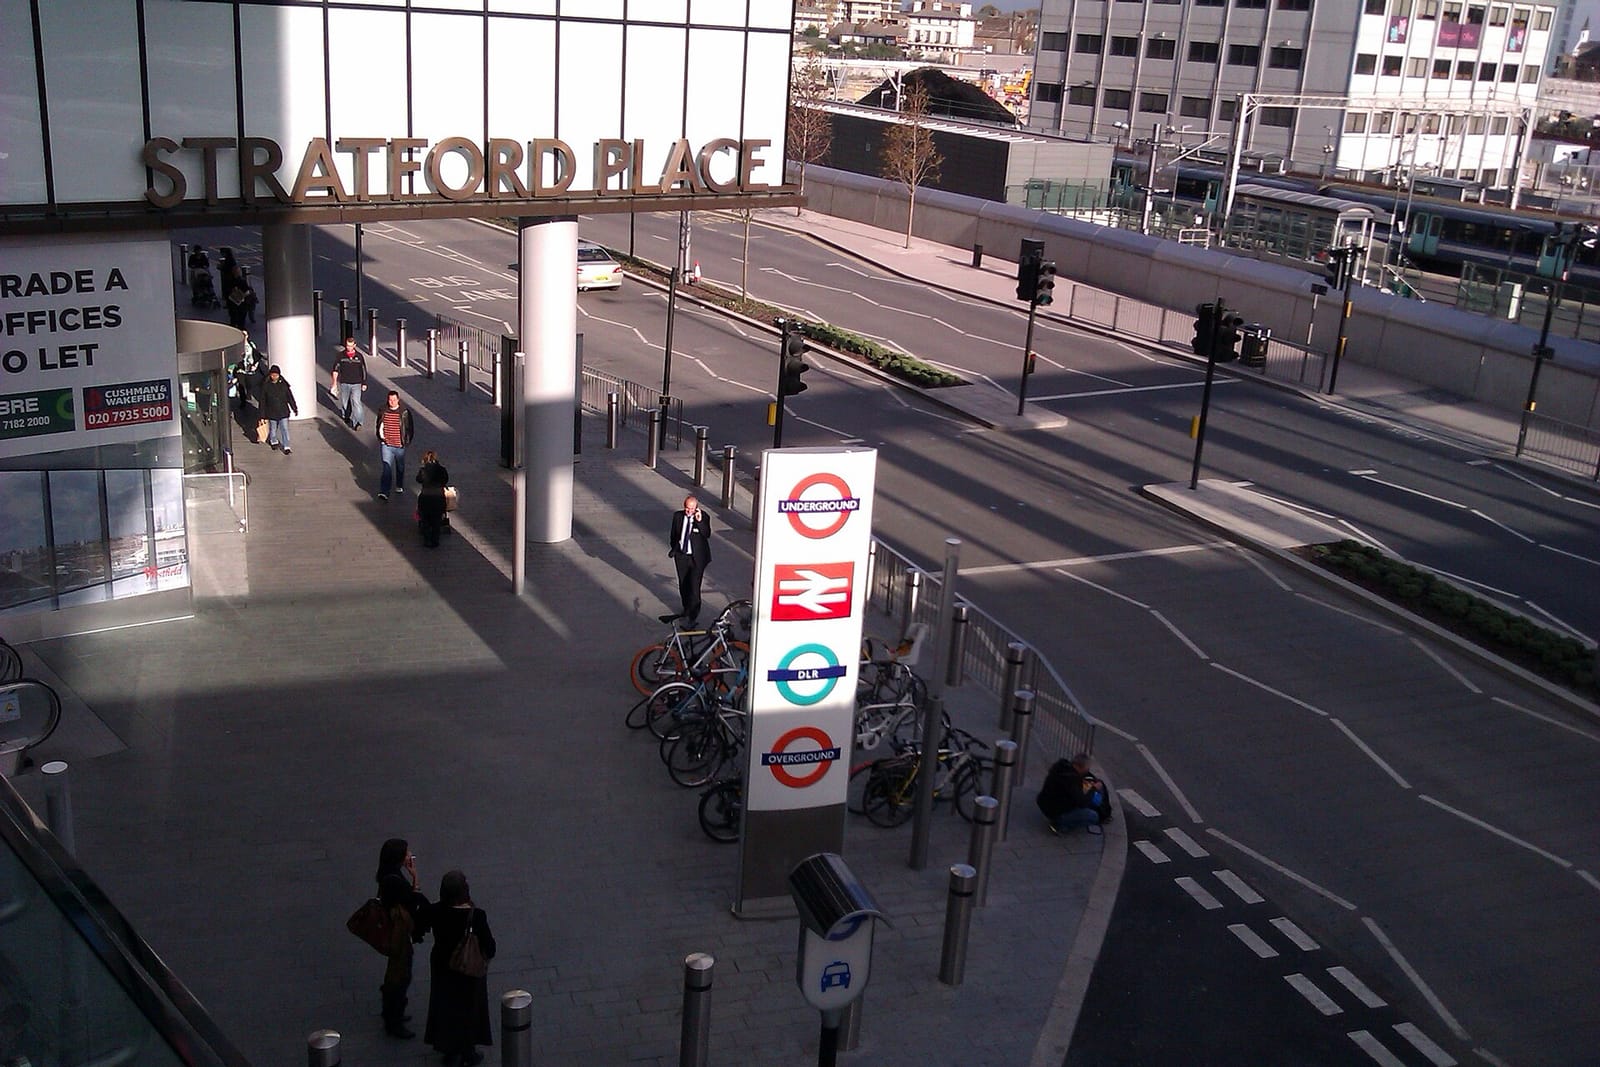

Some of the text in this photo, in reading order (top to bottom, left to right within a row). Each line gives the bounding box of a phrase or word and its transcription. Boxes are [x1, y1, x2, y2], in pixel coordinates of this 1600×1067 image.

[143, 136, 772, 208] STRATFORD PLACE
[104, 267, 129, 292] A
[408, 275, 481, 289] BUS
[433, 288, 519, 303] LANE
[0, 304, 122, 336] FFICES
[38, 343, 99, 371] LET
[104, 386, 159, 398] CUSHMAN
[105, 393, 165, 406] WAKEFIELD
[3, 415, 50, 430] 7182 2000
[88, 405, 170, 425] 020 7935 5000
[780, 500, 858, 512] UNDERGROUND
[797, 669, 819, 679] DLR
[768, 750, 835, 764] OVERGROUND
